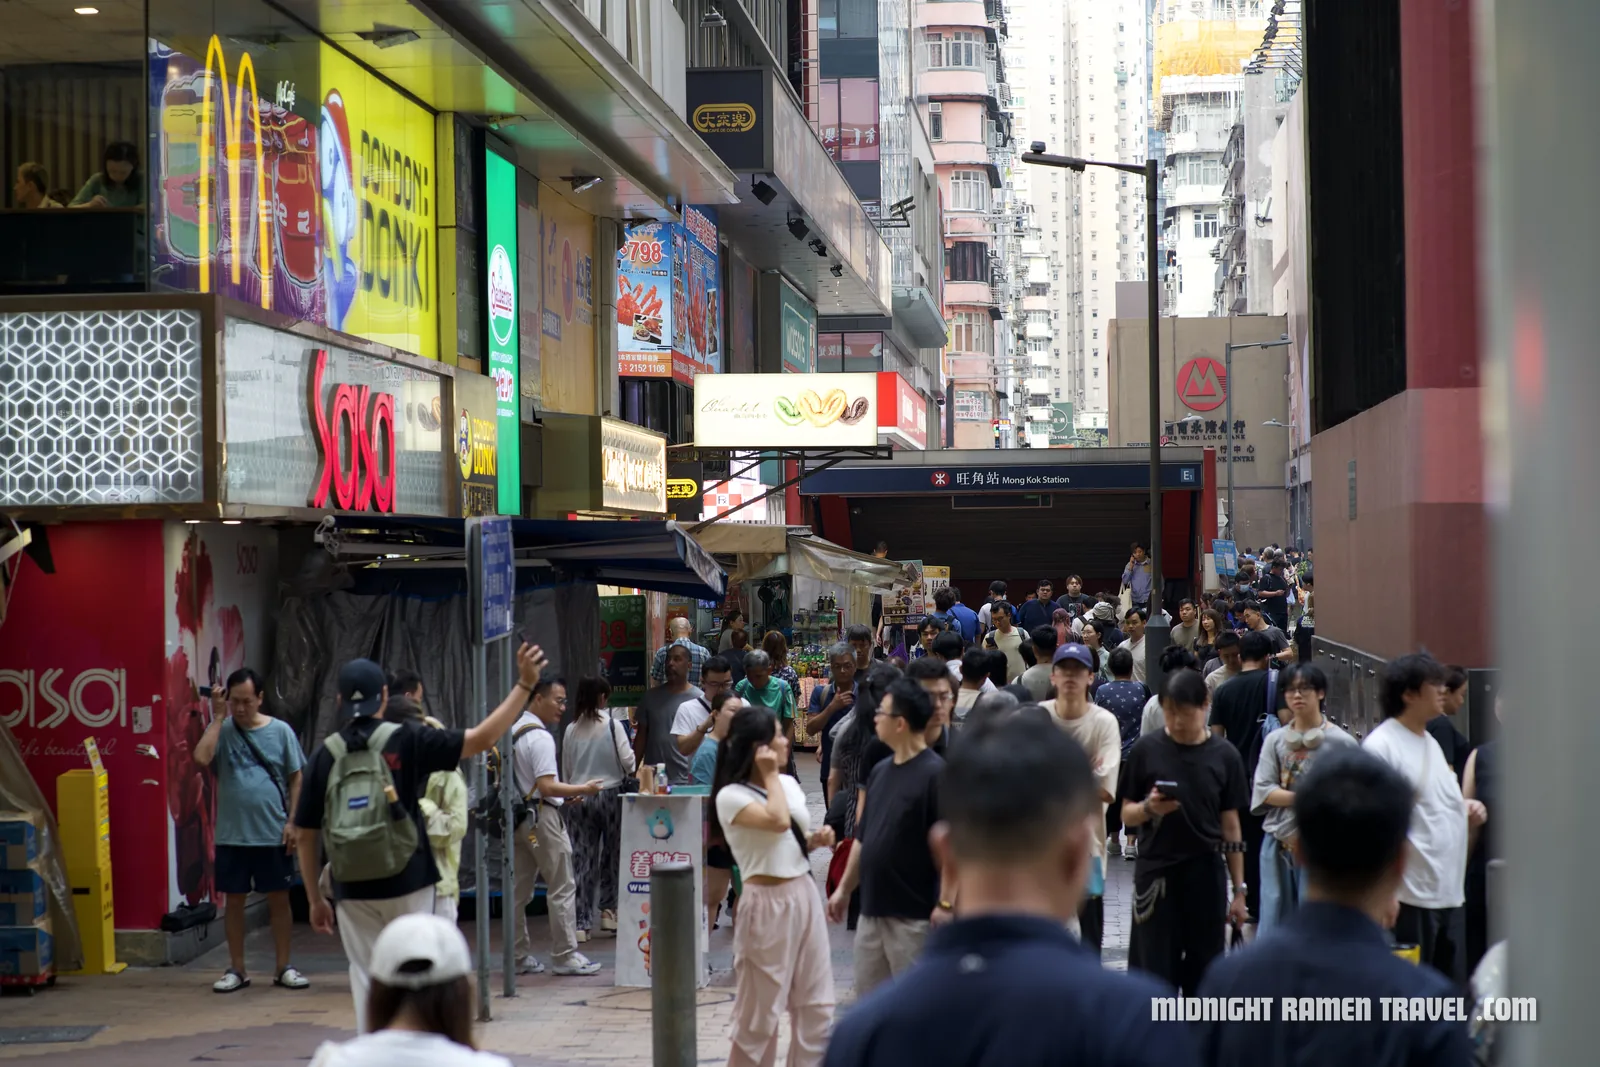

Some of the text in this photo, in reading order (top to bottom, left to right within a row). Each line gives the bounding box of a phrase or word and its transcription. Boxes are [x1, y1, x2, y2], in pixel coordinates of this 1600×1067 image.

[360, 198, 428, 312] DONKI
[629, 363, 647, 373] 2152
[956, 472, 1000, 486] 旺角站
[1002, 475, 1070, 485] Mong Kok Station
